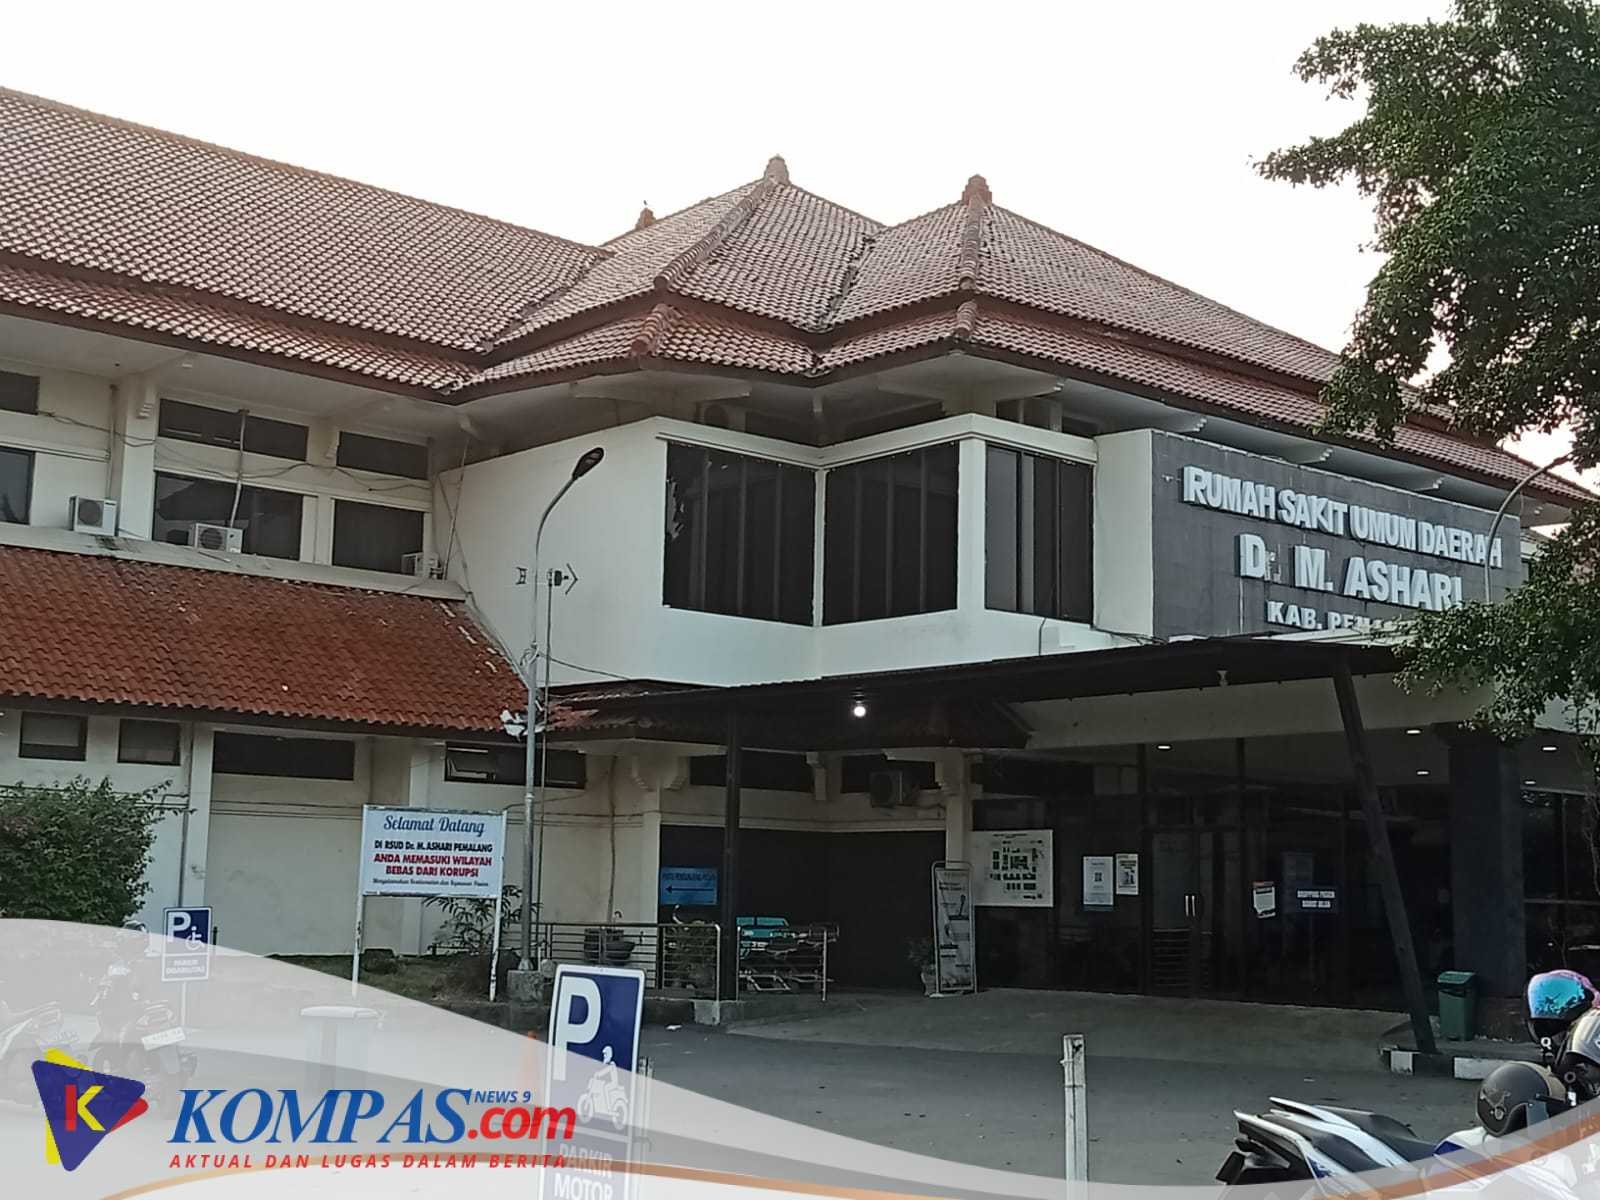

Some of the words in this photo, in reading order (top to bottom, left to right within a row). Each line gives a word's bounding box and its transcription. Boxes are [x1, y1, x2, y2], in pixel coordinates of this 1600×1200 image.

[1183, 465, 1277, 519] RUMAH
[1278, 490, 1348, 536] SAKIT
[1349, 505, 1418, 549] UMUM
[1418, 522, 1503, 568] DAERAH
[1294, 545, 1333, 591] M.
[1344, 557, 1463, 611] ASHARI
[1267, 601, 1322, 630] KAB.
[383, 815, 435, 831] Selamat
[438, 816, 485, 838] Datang
[374, 854, 400, 863] ANDA
[402, 854, 451, 865] MEMASUKI
[452, 855, 492, 866] WILAYAH
[375, 840, 383, 849] DI
[385, 840, 404, 850] RSUD
[454, 842, 493, 853] PEMALANG
[386, 865, 413, 875] BEBAS
[415, 866, 438, 876] DARI
[440, 867, 479, 878] KORUPSI
[167, 911, 192, 942] P
[552, 975, 602, 1081] P
[559, 1143, 613, 1178] PARKIR
